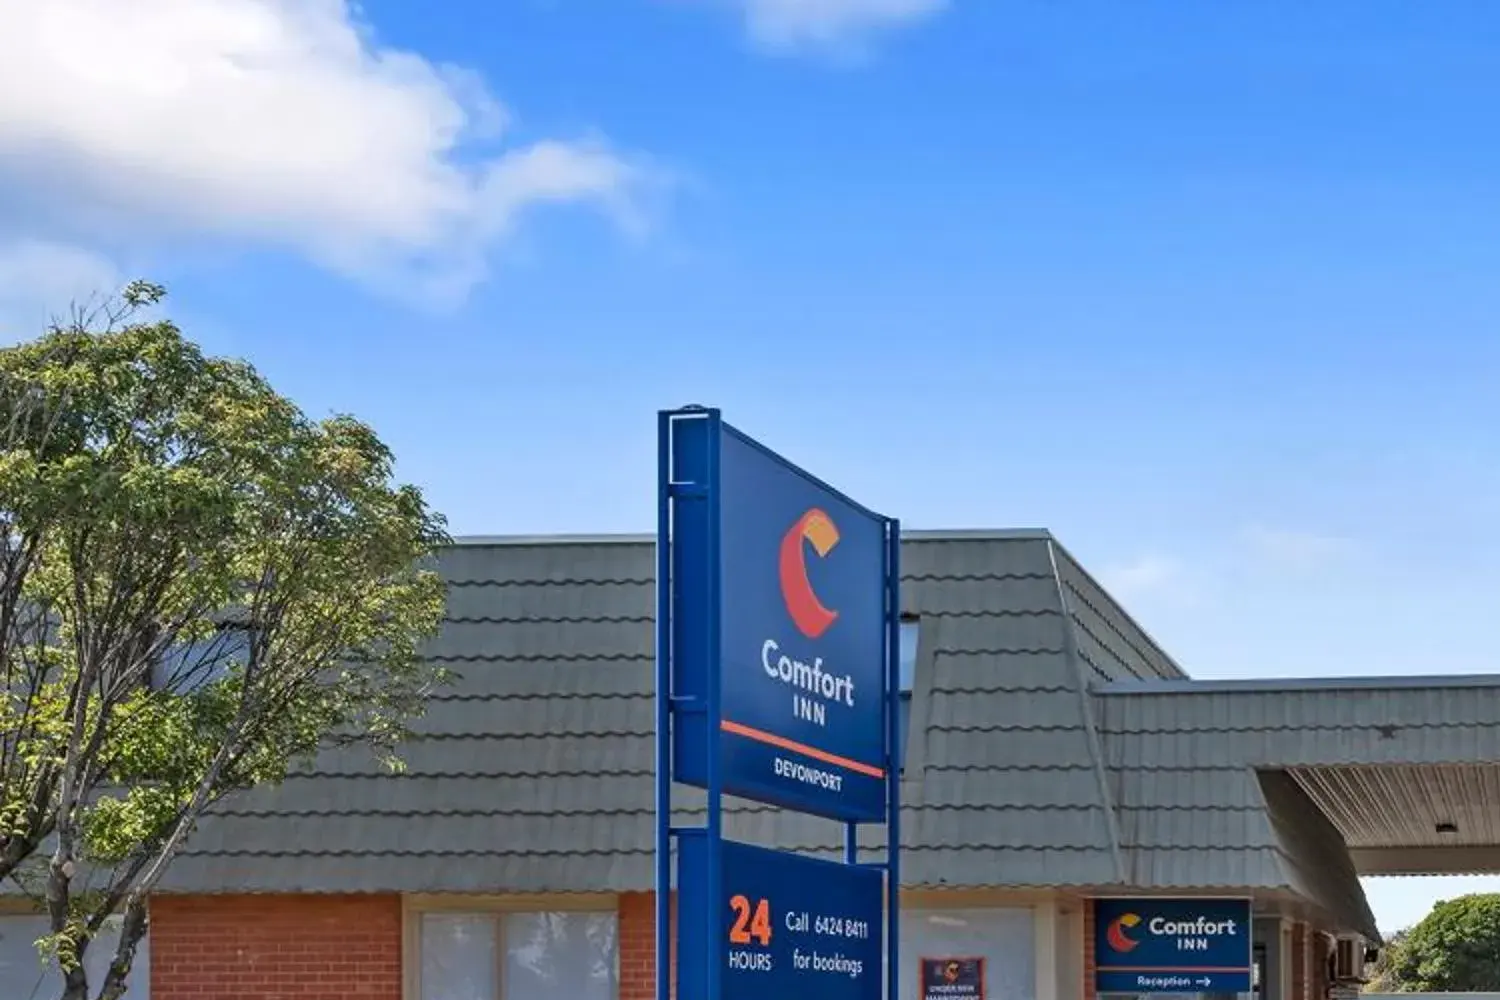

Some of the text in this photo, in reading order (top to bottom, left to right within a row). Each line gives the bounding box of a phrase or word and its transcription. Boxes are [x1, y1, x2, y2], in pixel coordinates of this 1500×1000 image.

[761, 640, 854, 706] Comfort
[793, 695, 826, 726] INN
[775, 757, 842, 793] DEVONPORT
[729, 894, 772, 945] 24
[785, 911, 868, 938] Call 6424 8411
[1149, 916, 1236, 935] Comfort
[1177, 938, 1208, 950] INN
[729, 951, 772, 972] HOURS
[793, 948, 863, 978] for bookings
[1137, 975, 1191, 988] Reception
